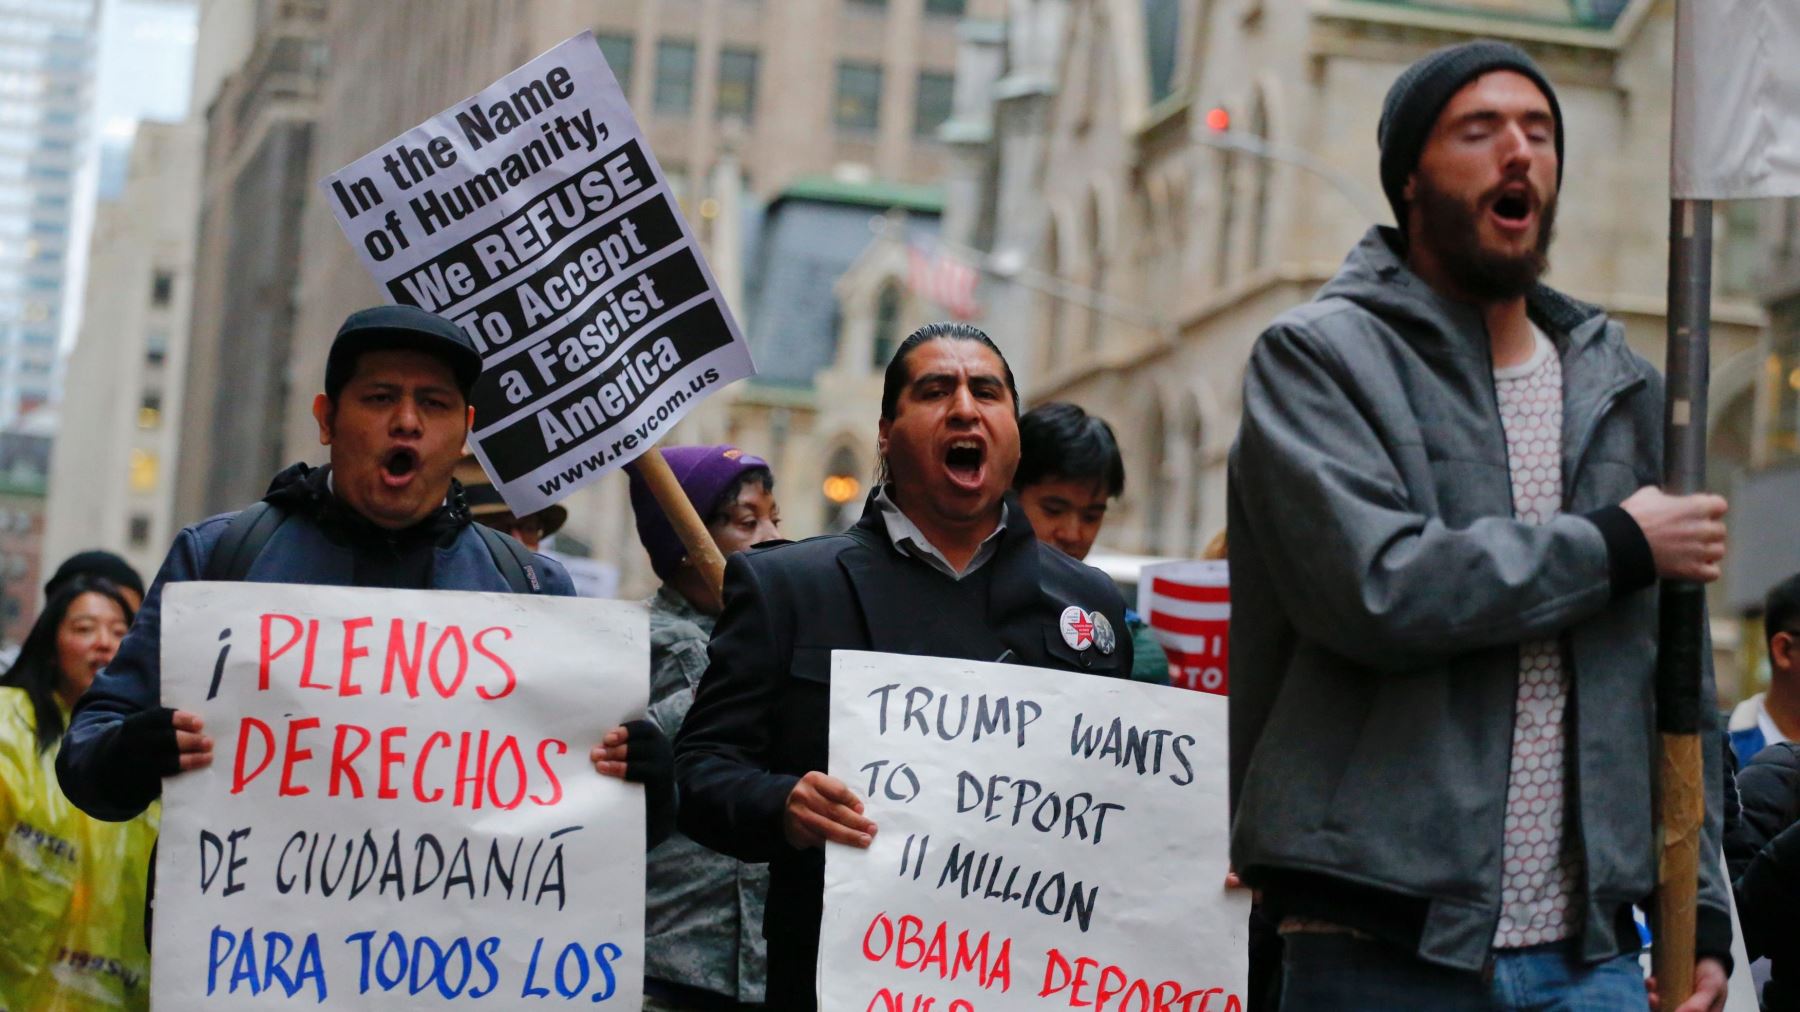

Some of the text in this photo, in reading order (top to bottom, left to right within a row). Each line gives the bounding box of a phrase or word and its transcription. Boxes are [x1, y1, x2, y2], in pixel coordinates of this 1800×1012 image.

[331, 66, 575, 218] In the Name
[364, 107, 609, 262] of Humanity,
[400, 151, 643, 313] We REFUSE
[454, 218, 647, 354] To Accept
[499, 273, 665, 404] a Fascist
[536, 336, 681, 453] America
[538, 366, 720, 497] www.revcom.us
[258, 613, 518, 701] PLENOS
[230, 717, 567, 810] DERECHOS
[867, 684, 1196, 786] TRUMP WANTS
[860, 760, 1125, 844] TO DEPORT
[200, 827, 252, 897] DE
[937, 843, 1098, 932] MILLION
[206, 925, 328, 1003] PARA
[345, 930, 500, 1000] TODOS
[522, 937, 622, 1003] LOS
[862, 911, 1011, 993] OBAMA
